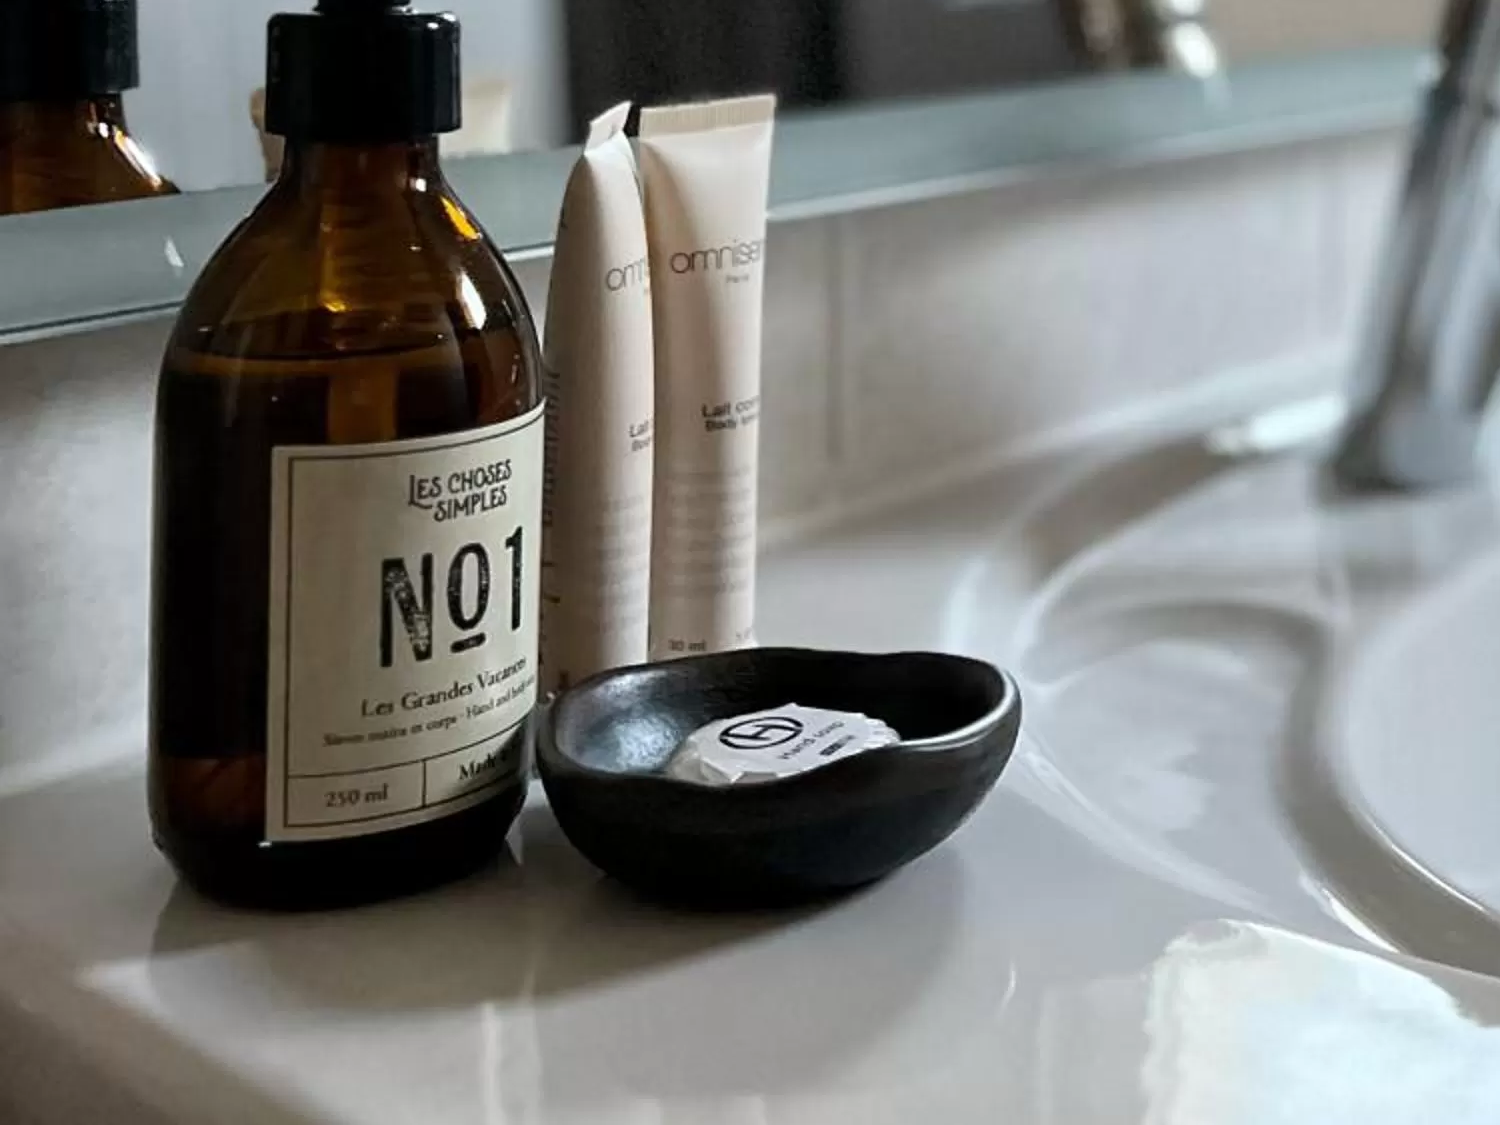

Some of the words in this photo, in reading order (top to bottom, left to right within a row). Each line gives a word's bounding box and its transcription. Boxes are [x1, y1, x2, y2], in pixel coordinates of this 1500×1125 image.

[407, 474, 443, 510] LES
[447, 459, 512, 494] CHOSES
[433, 485, 507, 522] SIMPLES
[361, 698, 394, 718] Les
[400, 678, 474, 711] Grandes
[323, 789, 361, 808] 250
[364, 782, 389, 804] ml
